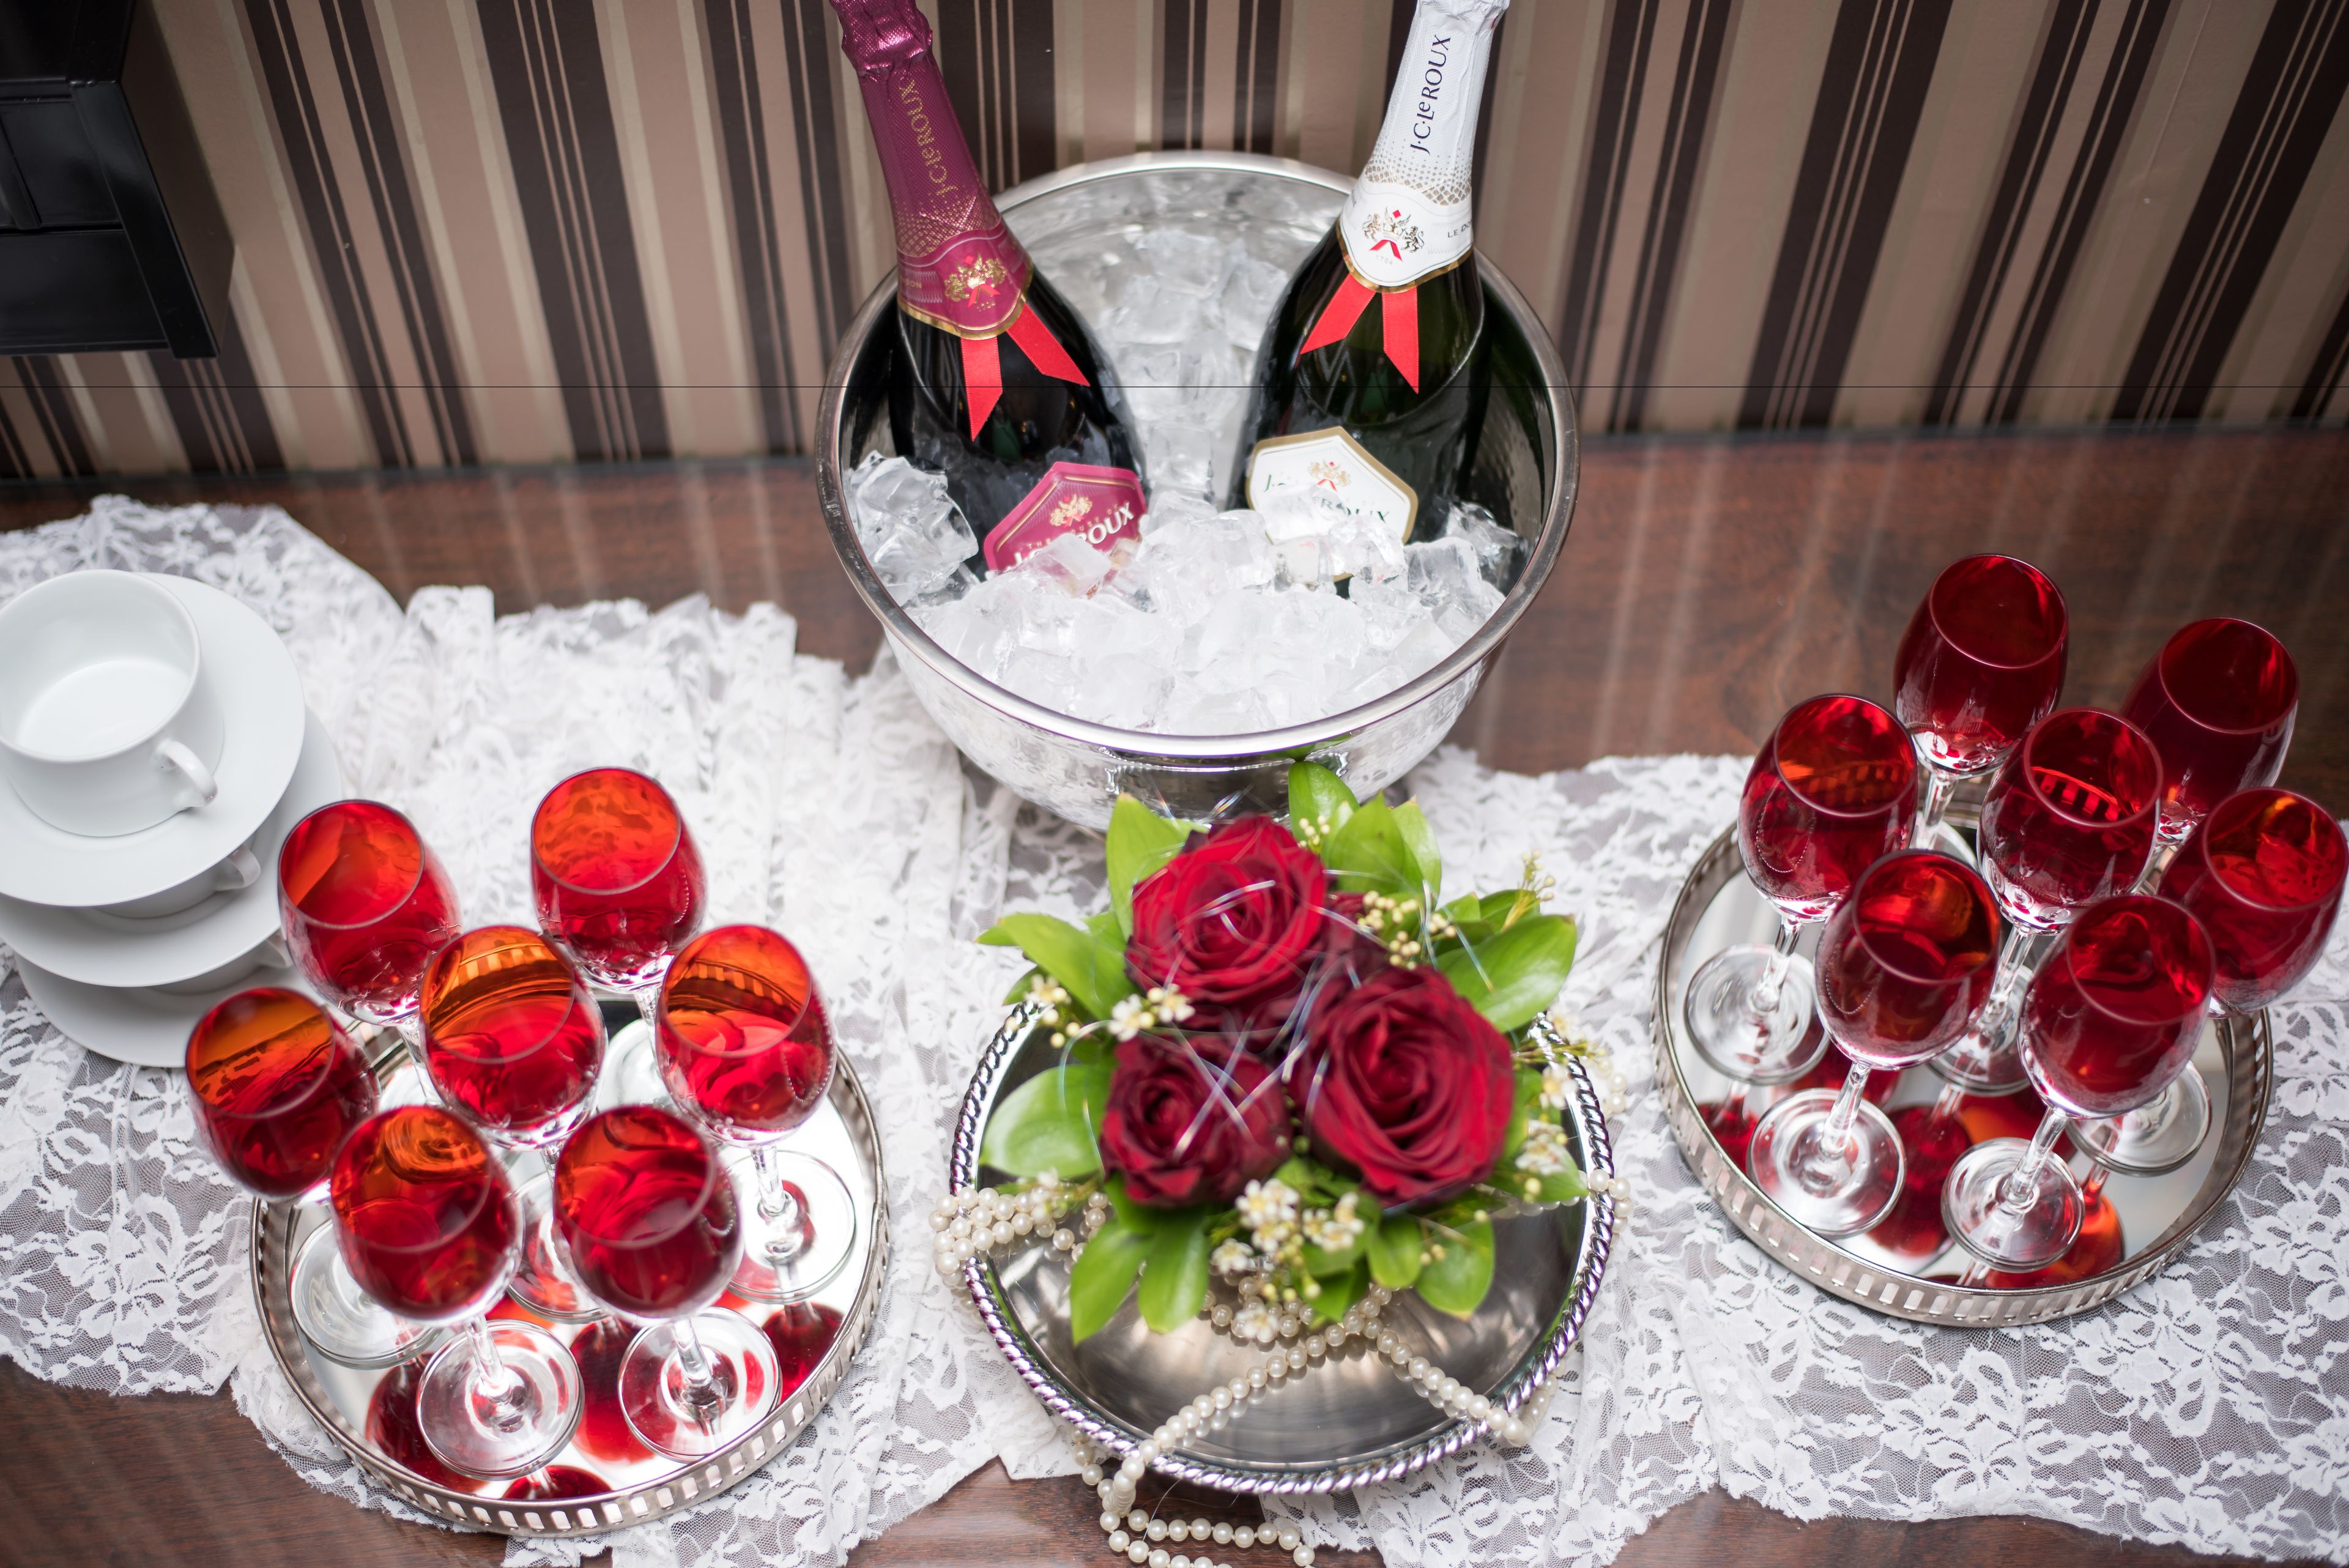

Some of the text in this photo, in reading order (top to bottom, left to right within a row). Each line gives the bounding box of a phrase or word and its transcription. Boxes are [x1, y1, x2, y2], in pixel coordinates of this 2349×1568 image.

[1448, 228, 1458, 237] LE
[1027, 504, 1118, 549] THE OUSE OF
